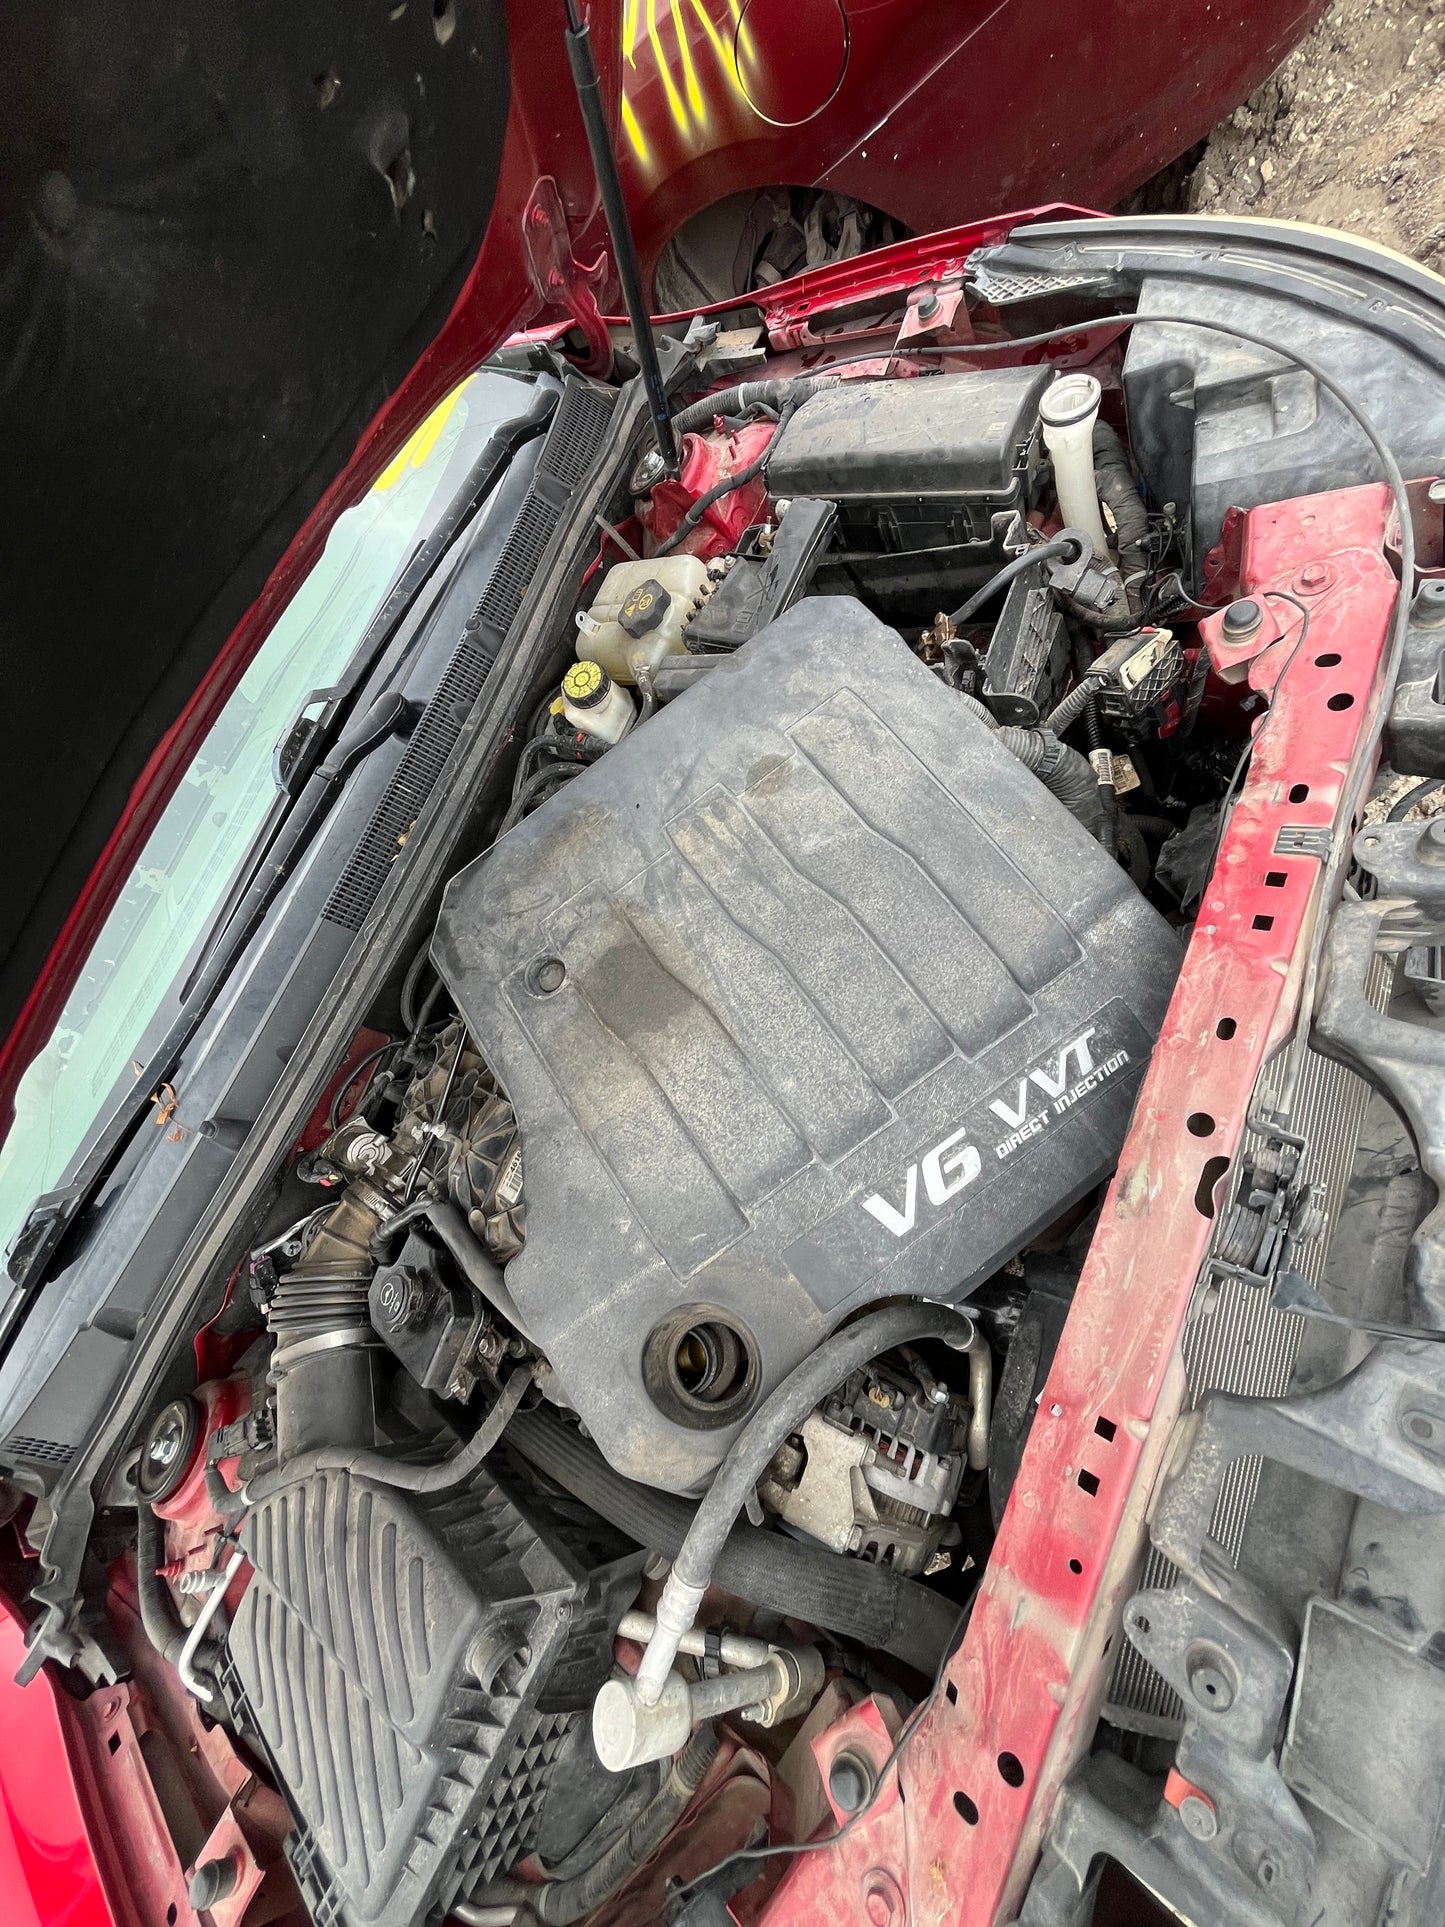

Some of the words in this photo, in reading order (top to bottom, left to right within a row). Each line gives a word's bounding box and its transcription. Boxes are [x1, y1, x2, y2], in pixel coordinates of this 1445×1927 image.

[861, 1126, 982, 1237] V6
[988, 1027, 1096, 1129] VVT
[993, 1109, 1050, 1160] DIRECT
[1053, 1050, 1131, 1115] INJECTION
